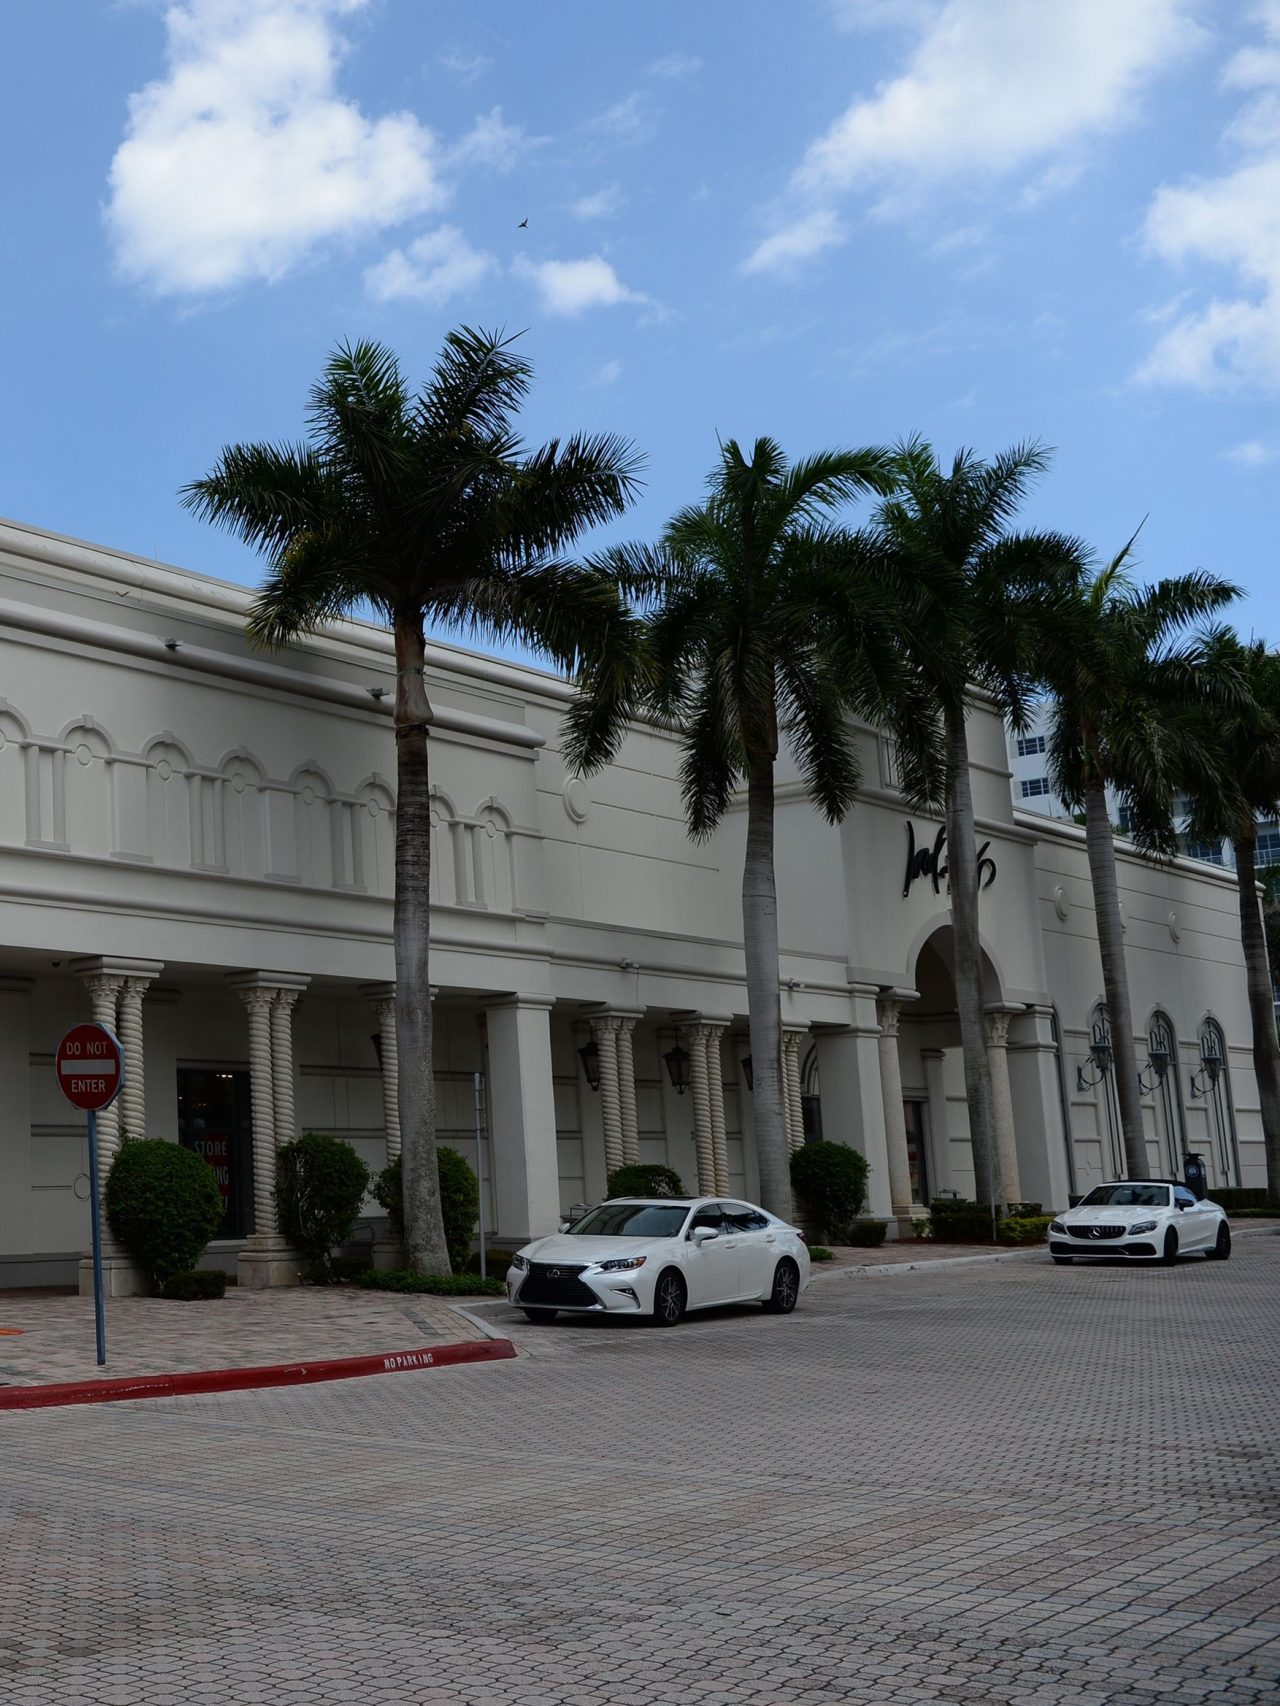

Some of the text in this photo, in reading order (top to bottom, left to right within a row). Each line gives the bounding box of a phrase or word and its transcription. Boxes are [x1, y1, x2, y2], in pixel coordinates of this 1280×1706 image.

[66, 1041, 108, 1055] DO NOT
[71, 1079, 106, 1093] ENTER
[194, 1140, 227, 1156] STORE
[383, 1353, 434, 1370] NO PARKING
